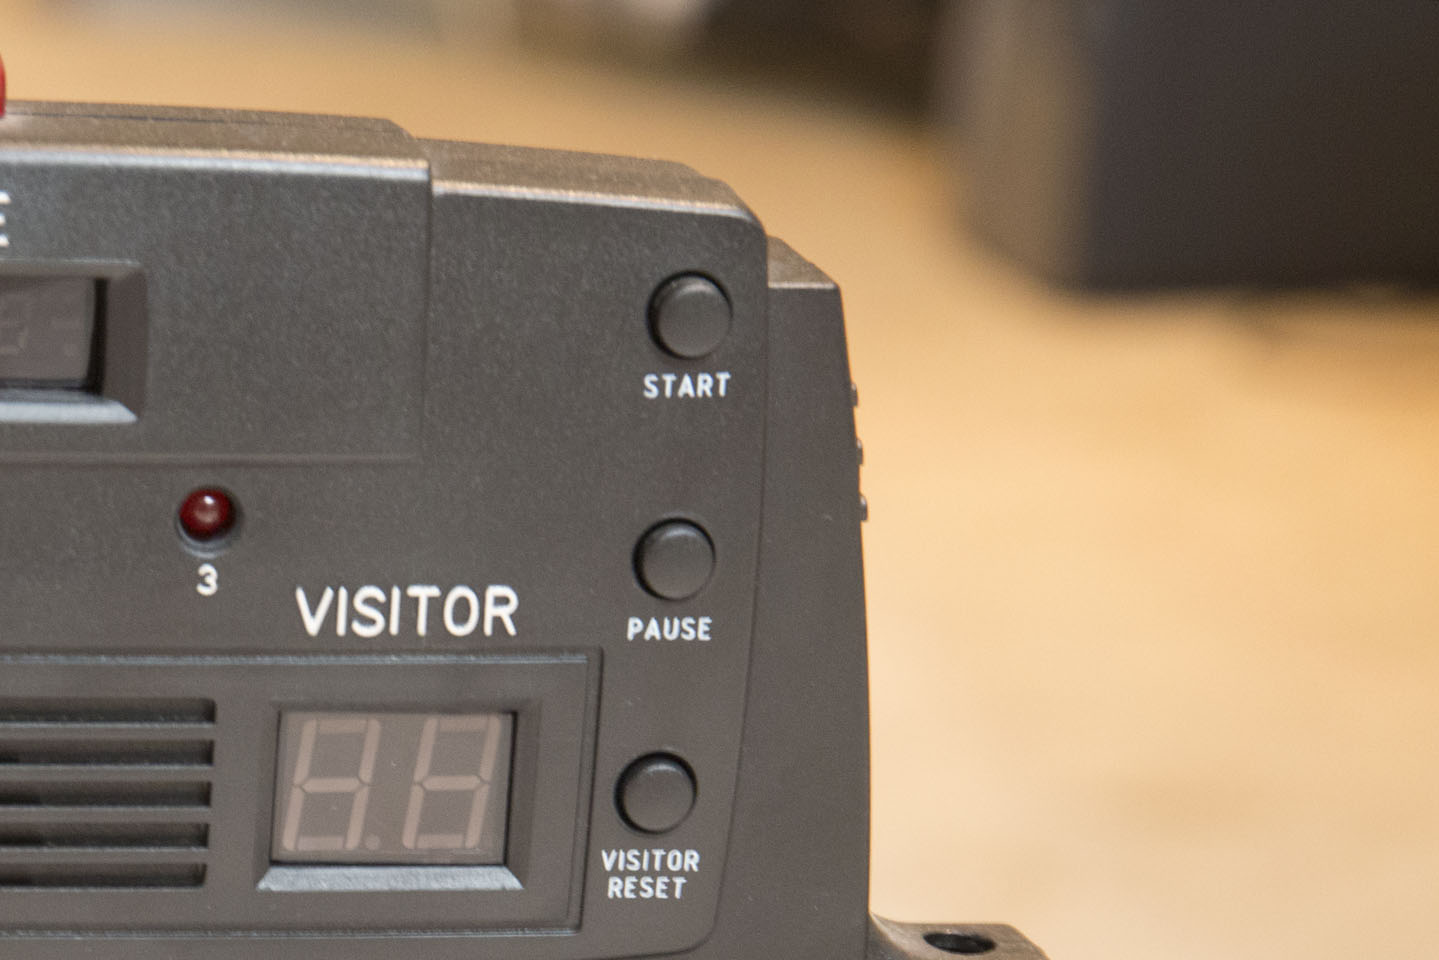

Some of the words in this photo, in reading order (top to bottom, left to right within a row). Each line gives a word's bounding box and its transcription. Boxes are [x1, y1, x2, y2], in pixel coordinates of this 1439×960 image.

[643, 372, 731, 399] START
[196, 563, 218, 596] 3
[295, 584, 519, 638] VISITOR
[627, 616, 712, 641] PAUSE
[601, 849, 700, 872] VISITOR
[607, 876, 687, 899] RESET
